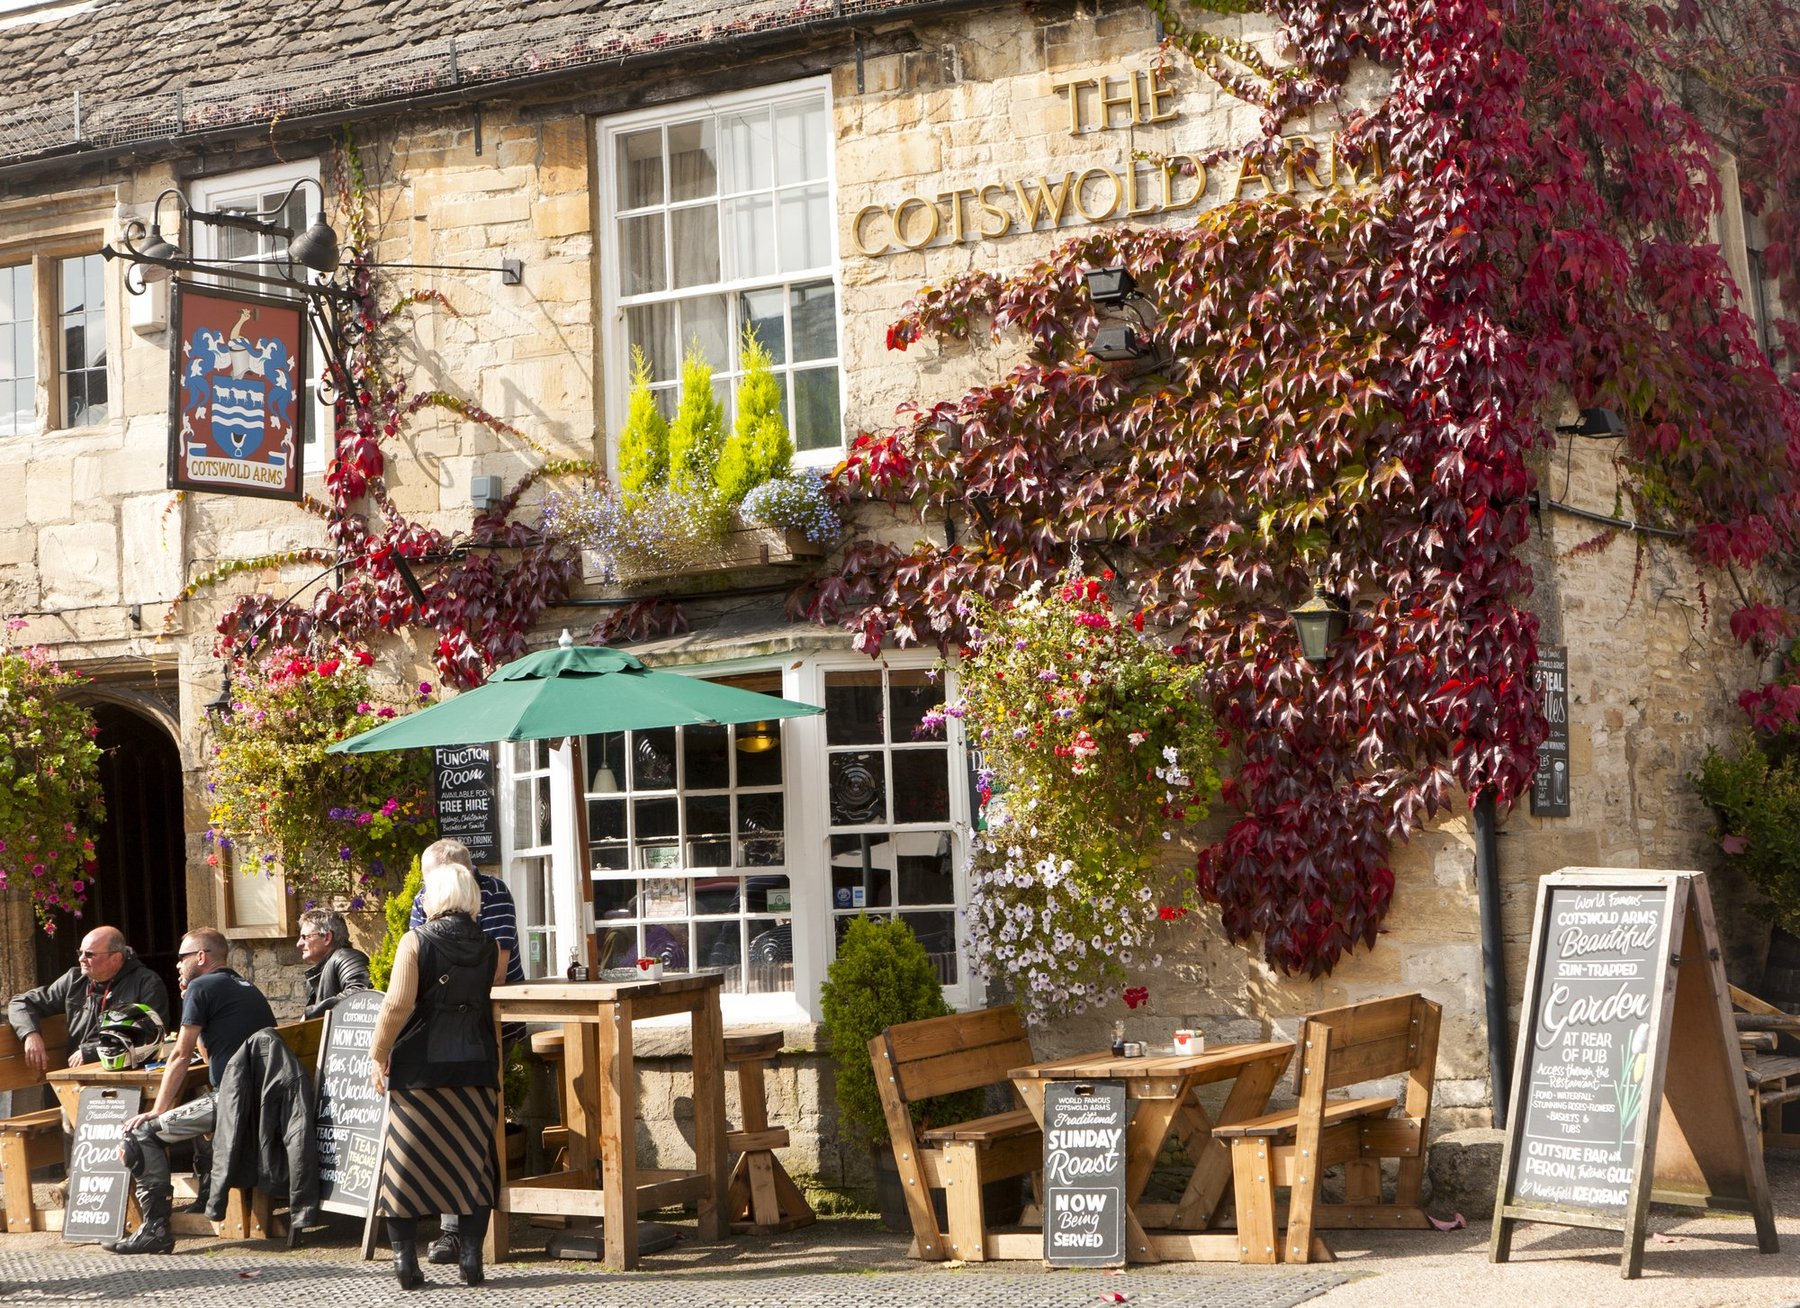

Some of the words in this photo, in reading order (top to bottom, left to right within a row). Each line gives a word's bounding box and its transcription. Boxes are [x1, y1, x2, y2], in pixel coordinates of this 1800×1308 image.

[1052, 64, 1180, 136] THE
[851, 153, 1207, 258] COTSWOLD
[1230, 130, 1385, 202] ARM
[191, 460, 251, 480] COTSWOLD
[253, 465, 283, 486] ARMS
[1535, 670, 1542, 691] 3
[436, 748, 490, 765] FUNCTION
[1540, 754, 1550, 767] LES
[441, 790, 474, 799] AVAILABLE
[475, 789, 488, 797] FOR
[1574, 892, 1606, 910] World
[1608, 892, 1642, 907] Famous
[1557, 911, 1619, 926] COTSWOLD
[1620, 910, 1658, 925] ARMS
[1558, 923, 1658, 959] Beautiful
[1558, 963, 1638, 977] SUN-TRAPPED
[343, 1012, 373, 1023] COTSWOLD
[1536, 982, 1650, 1050] Garden
[332, 1028, 354, 1047] NOW
[1562, 1032, 1579, 1046] AT
[1581, 1032, 1612, 1048] REAR
[1562, 1048, 1579, 1062] OF
[1582, 1049, 1607, 1063] PUB
[349, 1054, 373, 1078] Coffe
[1537, 1063, 1564, 1076] Access
[1566, 1063, 1593, 1080] through
[1595, 1065, 1610, 1078] the
[323, 1076, 339, 1096] Hot
[1550, 1076, 1600, 1090] Restaurant
[1054, 1112, 1117, 1127] Traditional
[1561, 1123, 1580, 1133] TUBS
[78, 1123, 123, 1141] SUNDA
[316, 1127, 350, 1141] TEACAKES
[1048, 1128, 1122, 1150] SUNDAY
[355, 1137, 371, 1154] TEA
[1528, 1141, 1581, 1161] OUTSIDE
[1584, 1148, 1608, 1164] BAR
[73, 1141, 121, 1171] Roas
[349, 1150, 376, 1168] TEACAKE
[1047, 1148, 1119, 1185] Roast
[1607, 1166, 1634, 1183] GOLD
[78, 1176, 115, 1193] NOW
[76, 1193, 107, 1211] Being
[1056, 1194, 1107, 1212] NOW
[70, 1210, 110, 1225] SERVED
[1058, 1211, 1100, 1234] Being
[1054, 1231, 1103, 1248] SERVED
